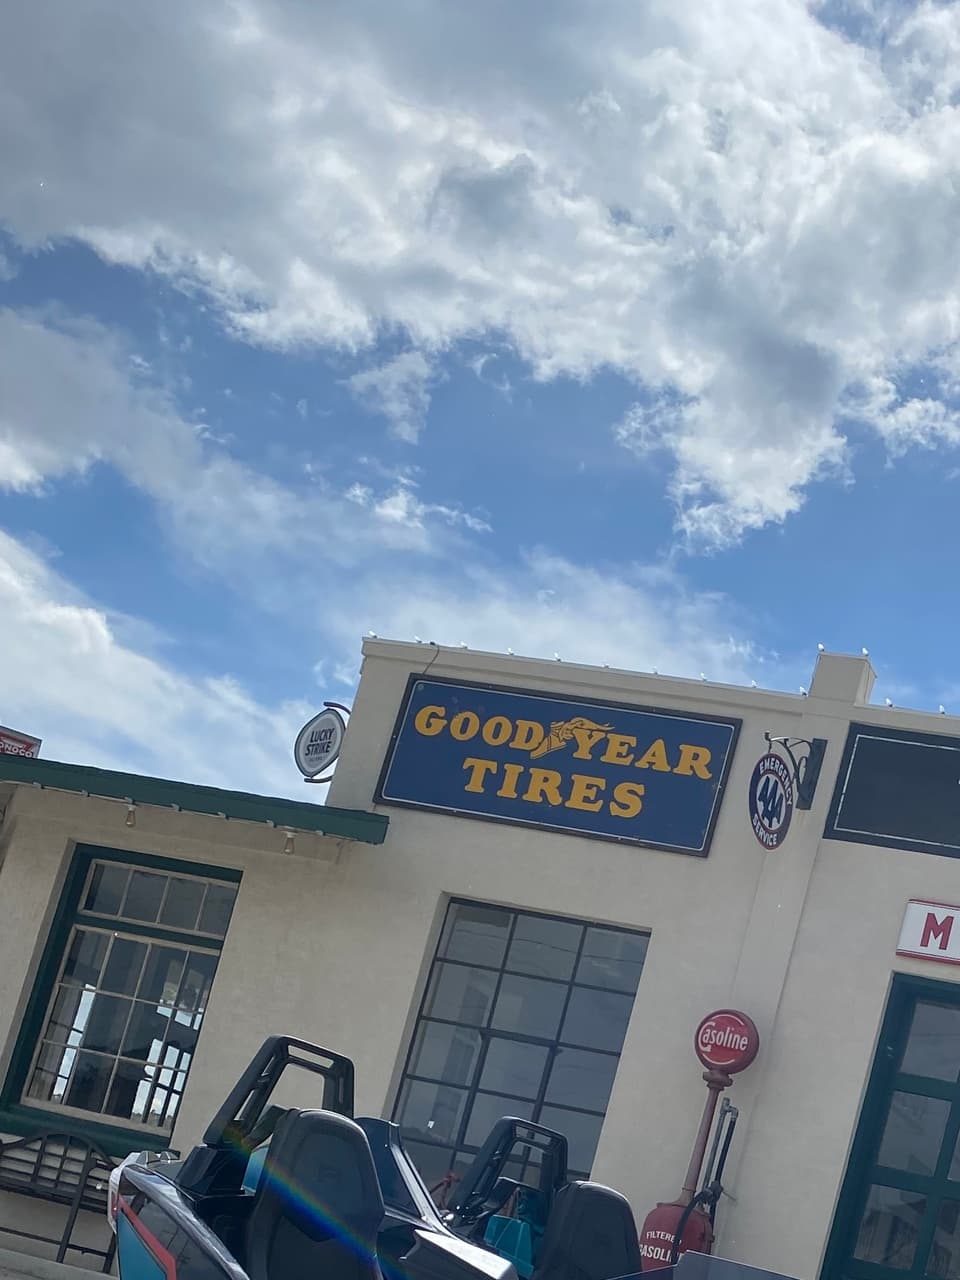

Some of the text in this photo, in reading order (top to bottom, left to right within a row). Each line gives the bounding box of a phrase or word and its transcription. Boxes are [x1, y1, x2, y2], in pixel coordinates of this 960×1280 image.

[305, 741, 332, 756] STRIKE
[310, 728, 335, 743] LUCKY
[462, 757, 646, 818] TIRES
[760, 757, 793, 806] EMERGENCY
[752, 813, 777, 846] SERVICE
[698, 1021, 748, 1051] Gasoline
